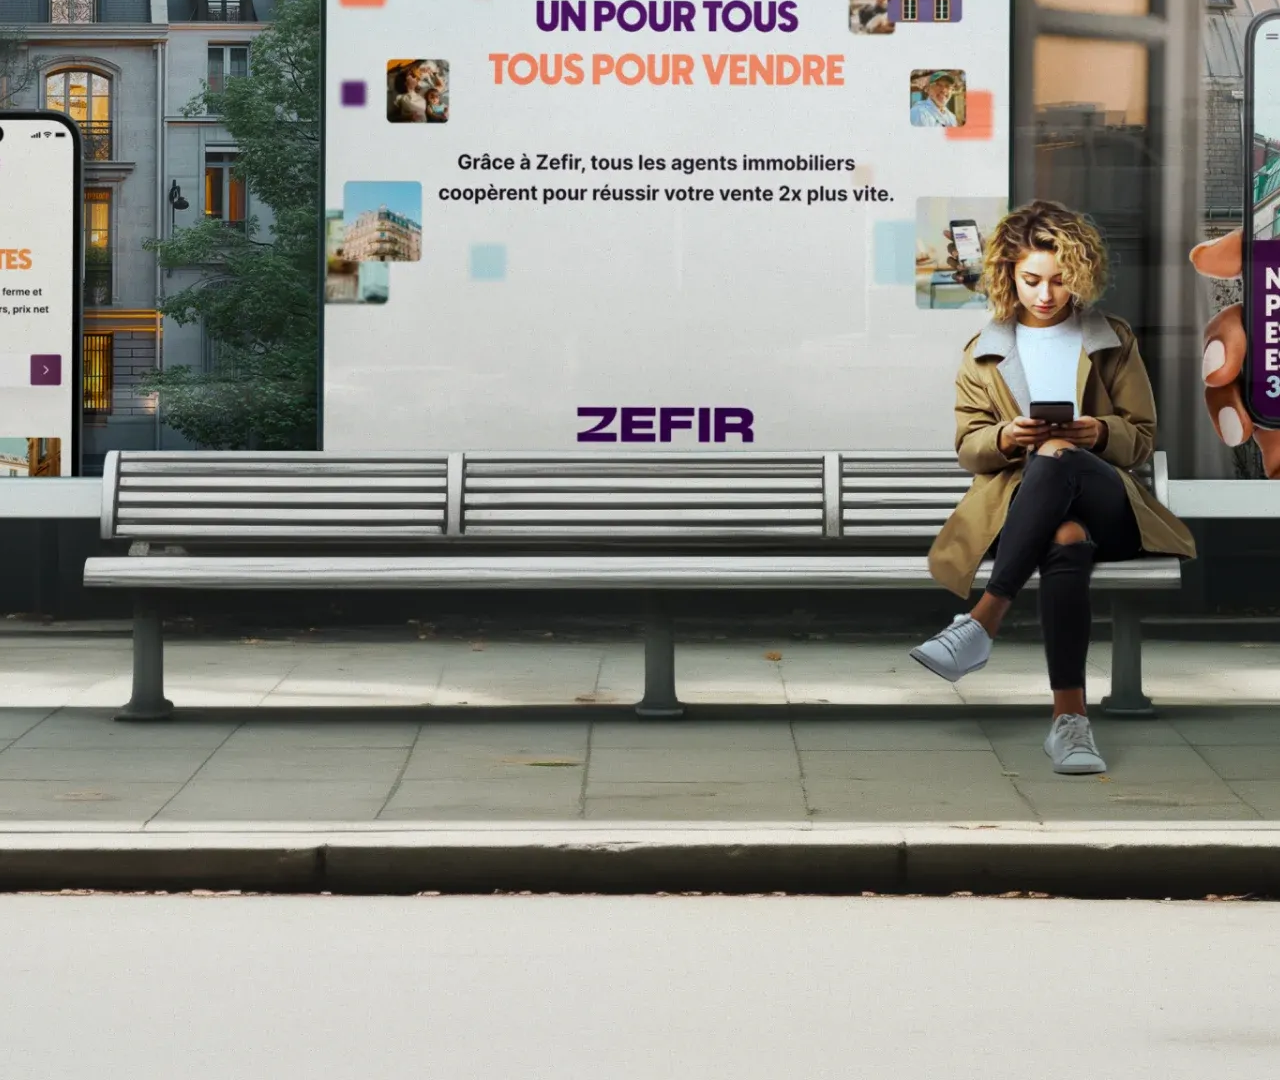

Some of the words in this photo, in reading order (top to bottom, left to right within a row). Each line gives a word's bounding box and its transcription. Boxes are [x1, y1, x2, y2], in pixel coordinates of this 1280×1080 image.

[536, 0, 586, 32] UN
[594, 0, 696, 32] POUR
[702, 0, 799, 33] TOUS
[488, 52, 584, 86] TOUS
[592, 53, 695, 86] POUR
[702, 54, 845, 86] VENDRE
[458, 153, 515, 170] Grâce
[520, 153, 530, 170] à
[537, 154, 585, 173] Zefir,
[591, 156, 633, 170] tous
[639, 155, 666, 170] les
[671, 156, 737, 174] agents
[743, 155, 855, 171] immobiliers
[439, 184, 537, 204] coopèrent
[543, 189, 587, 204] pour
[593, 184, 659, 201] réussir
[665, 186, 714, 201] votre
[720, 187, 773, 201] vente
[779, 185, 801, 201] 2x
[808, 186, 847, 205] plus
[853, 185, 893, 201] vite.
[2, 288, 30, 297] ferme
[32, 288, 42, 297] et
[13, 305, 31, 316] prix
[33, 306, 49, 314] net
[577, 407, 754, 443] ZEFIR
